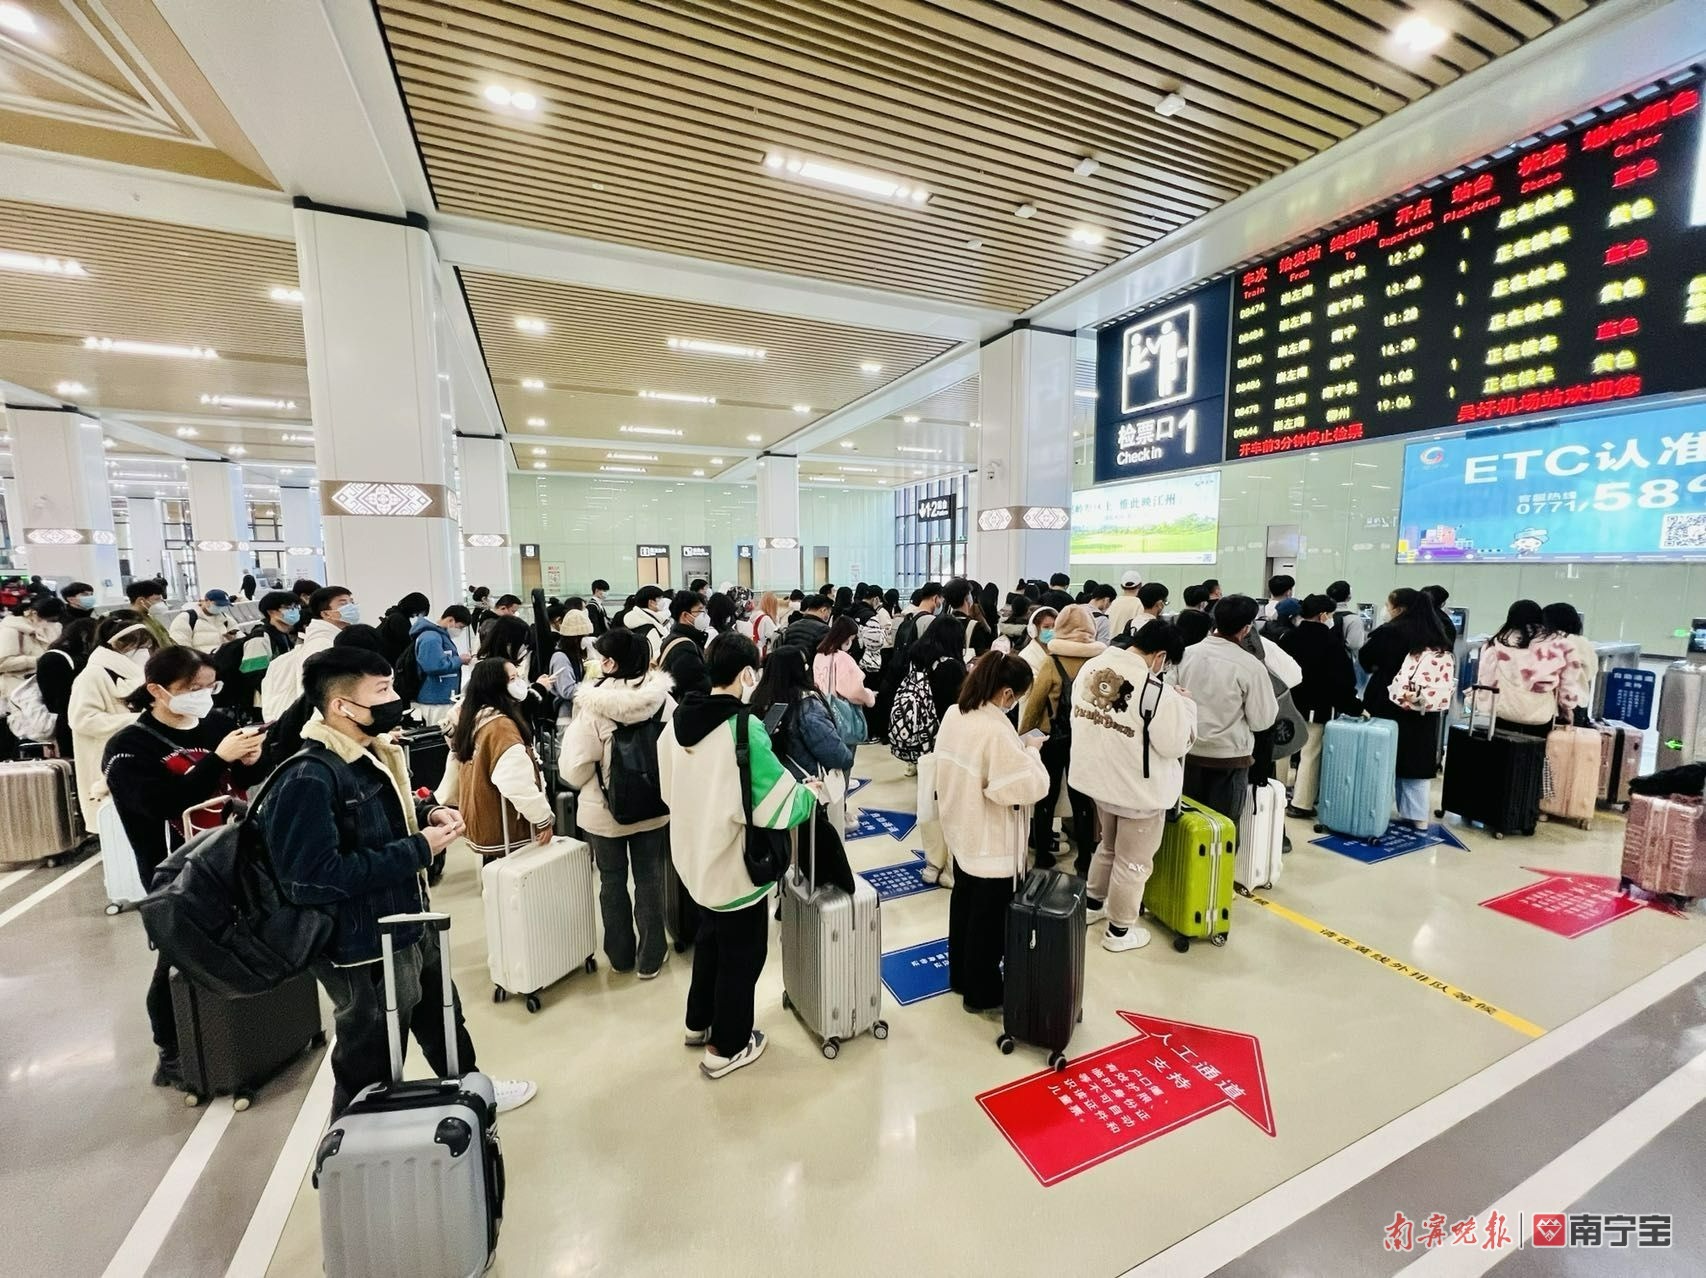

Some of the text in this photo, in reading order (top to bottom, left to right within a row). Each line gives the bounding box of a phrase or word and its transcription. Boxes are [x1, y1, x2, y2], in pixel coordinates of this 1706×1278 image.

[1242, 266, 1268, 287] 车次
[1279, 244, 1322, 274] 始发站
[1329, 220, 1379, 252] 终到站
[1395, 198, 1432, 227] 开点
[1451, 173, 1494, 203] 站台
[1518, 143, 1567, 177] 状态
[1243, 133, 1664, 300] Train From To Departure Platform State Color
[1497, 187, 1574, 230] 正在候车
[1494, 225, 1571, 264] 正在候车
[1491, 261, 1567, 298] 正在候车
[1488, 299, 1563, 332] 正在候车
[1485, 334, 1559, 365] 正在候车
[1377, 395, 1412, 412] 19:06
[1482, 365, 1556, 394] 正在候车
[1457, 373, 1642, 422] 吴圩机场站欢迎您
[1117, 408, 1197, 455] 检票口 1
[1239, 422, 1364, 457] 开车前3分钟停止检票
[1116, 445, 1163, 466] Check in
[1464, 430, 1706, 485] ETC认准
[1319, 927, 1497, 1016] 请在黄线外排队等候
[1146, 1056, 1193, 1090] 支持
[1150, 1032, 1247, 1100] 人工通道
[1063, 1078, 1121, 1134] 识读证件和
[1078, 1072, 1136, 1128] 等不可自动
[1091, 1067, 1151, 1122] 临时身份证
